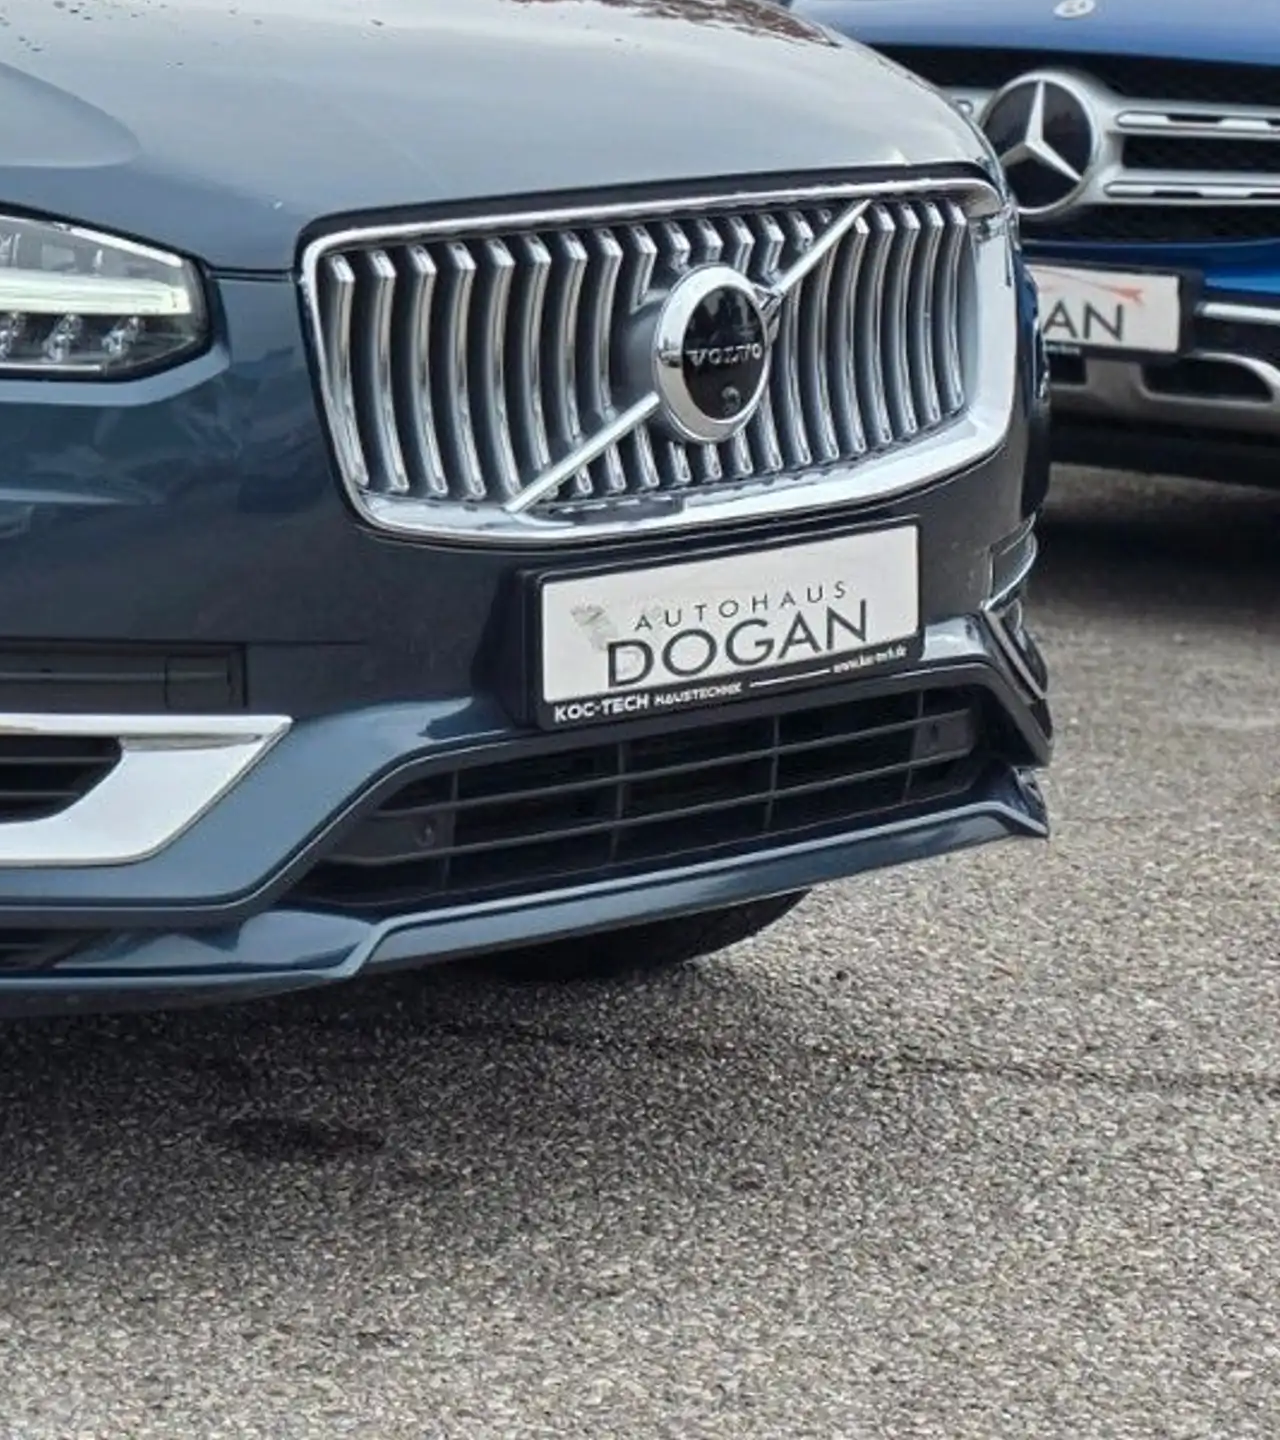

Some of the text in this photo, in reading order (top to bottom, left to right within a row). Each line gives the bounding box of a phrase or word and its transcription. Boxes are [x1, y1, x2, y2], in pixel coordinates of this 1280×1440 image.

[685, 343, 763, 367] VOLVO
[634, 579, 847, 632] AUTOHAUS
[607, 599, 867, 688] DOGAN
[553, 693, 650, 723] KOC-TECH
